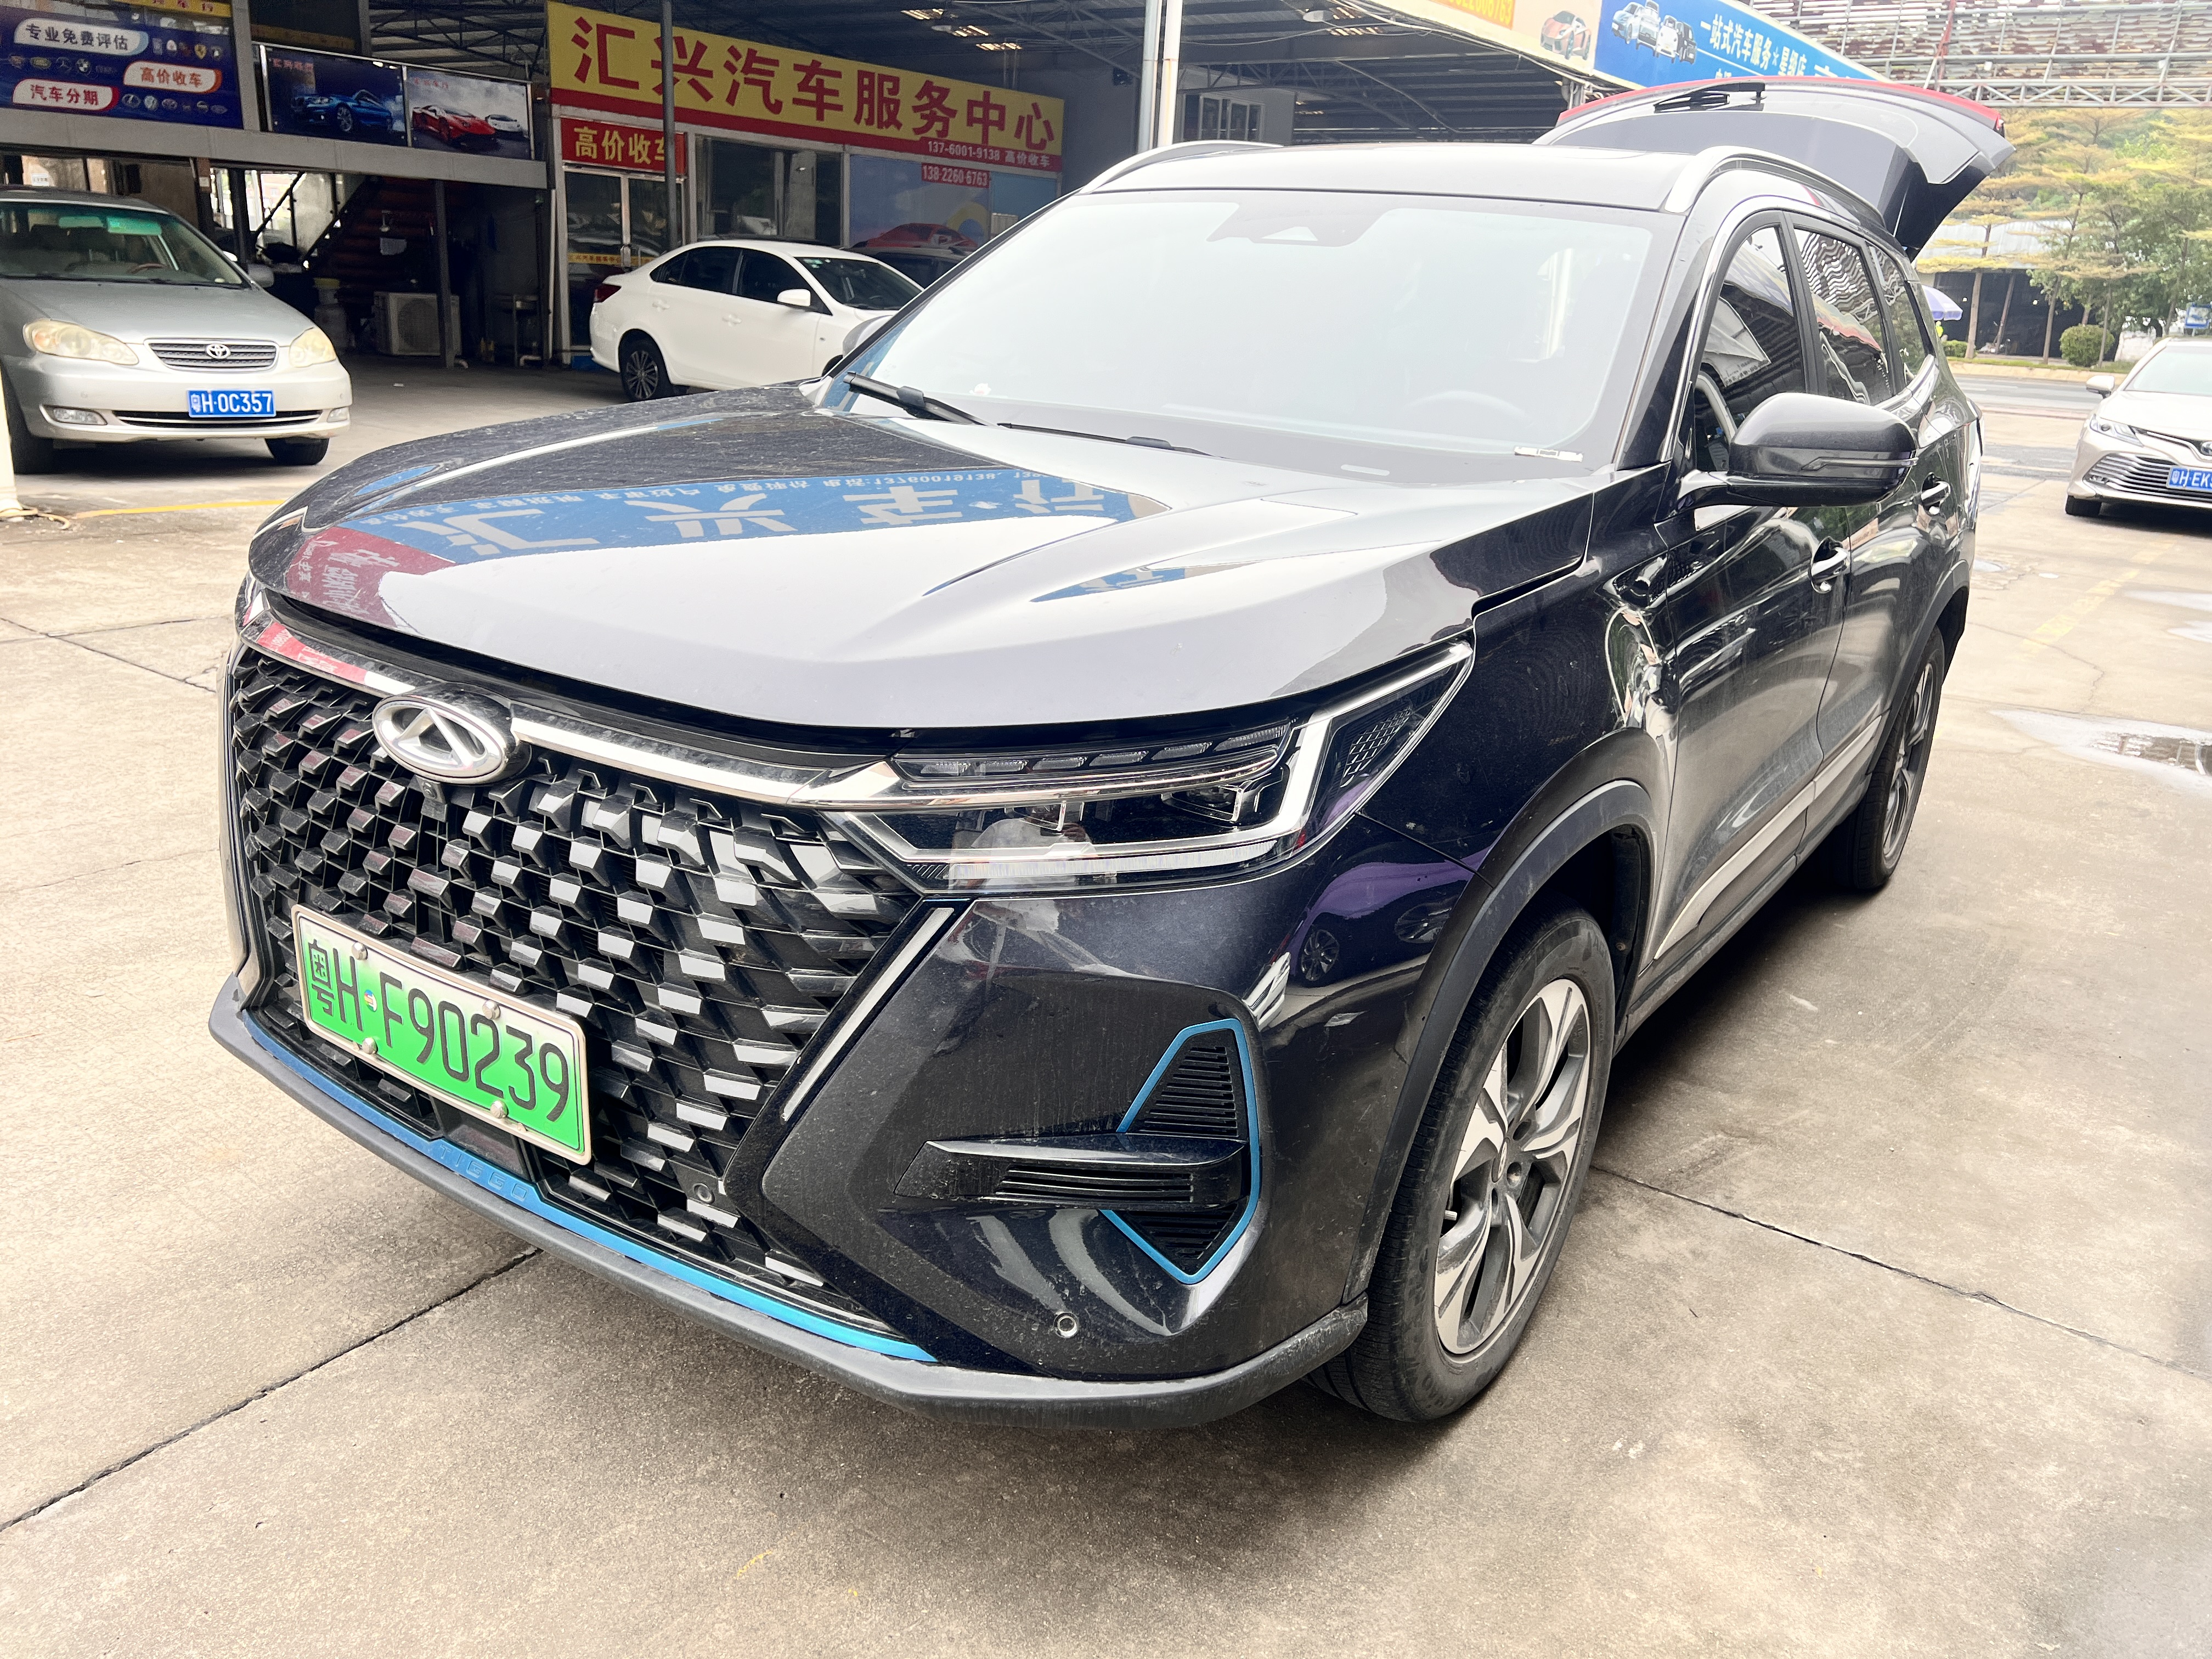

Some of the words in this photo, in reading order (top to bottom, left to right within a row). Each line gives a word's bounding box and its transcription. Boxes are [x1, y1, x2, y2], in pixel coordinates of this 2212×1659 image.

[25, 23, 129, 51] 专业免费评估
[1700, 13, 1773, 71] 一站式汽车服务
[140, 67, 202, 88] 高价收车
[571, 16, 1054, 151] 汇兴汽车服务中心
[30, 84, 99, 106] 汽车分期
[1005, 150, 1051, 167] 高价收车
[439, 1144, 529, 1202] TIGGO
